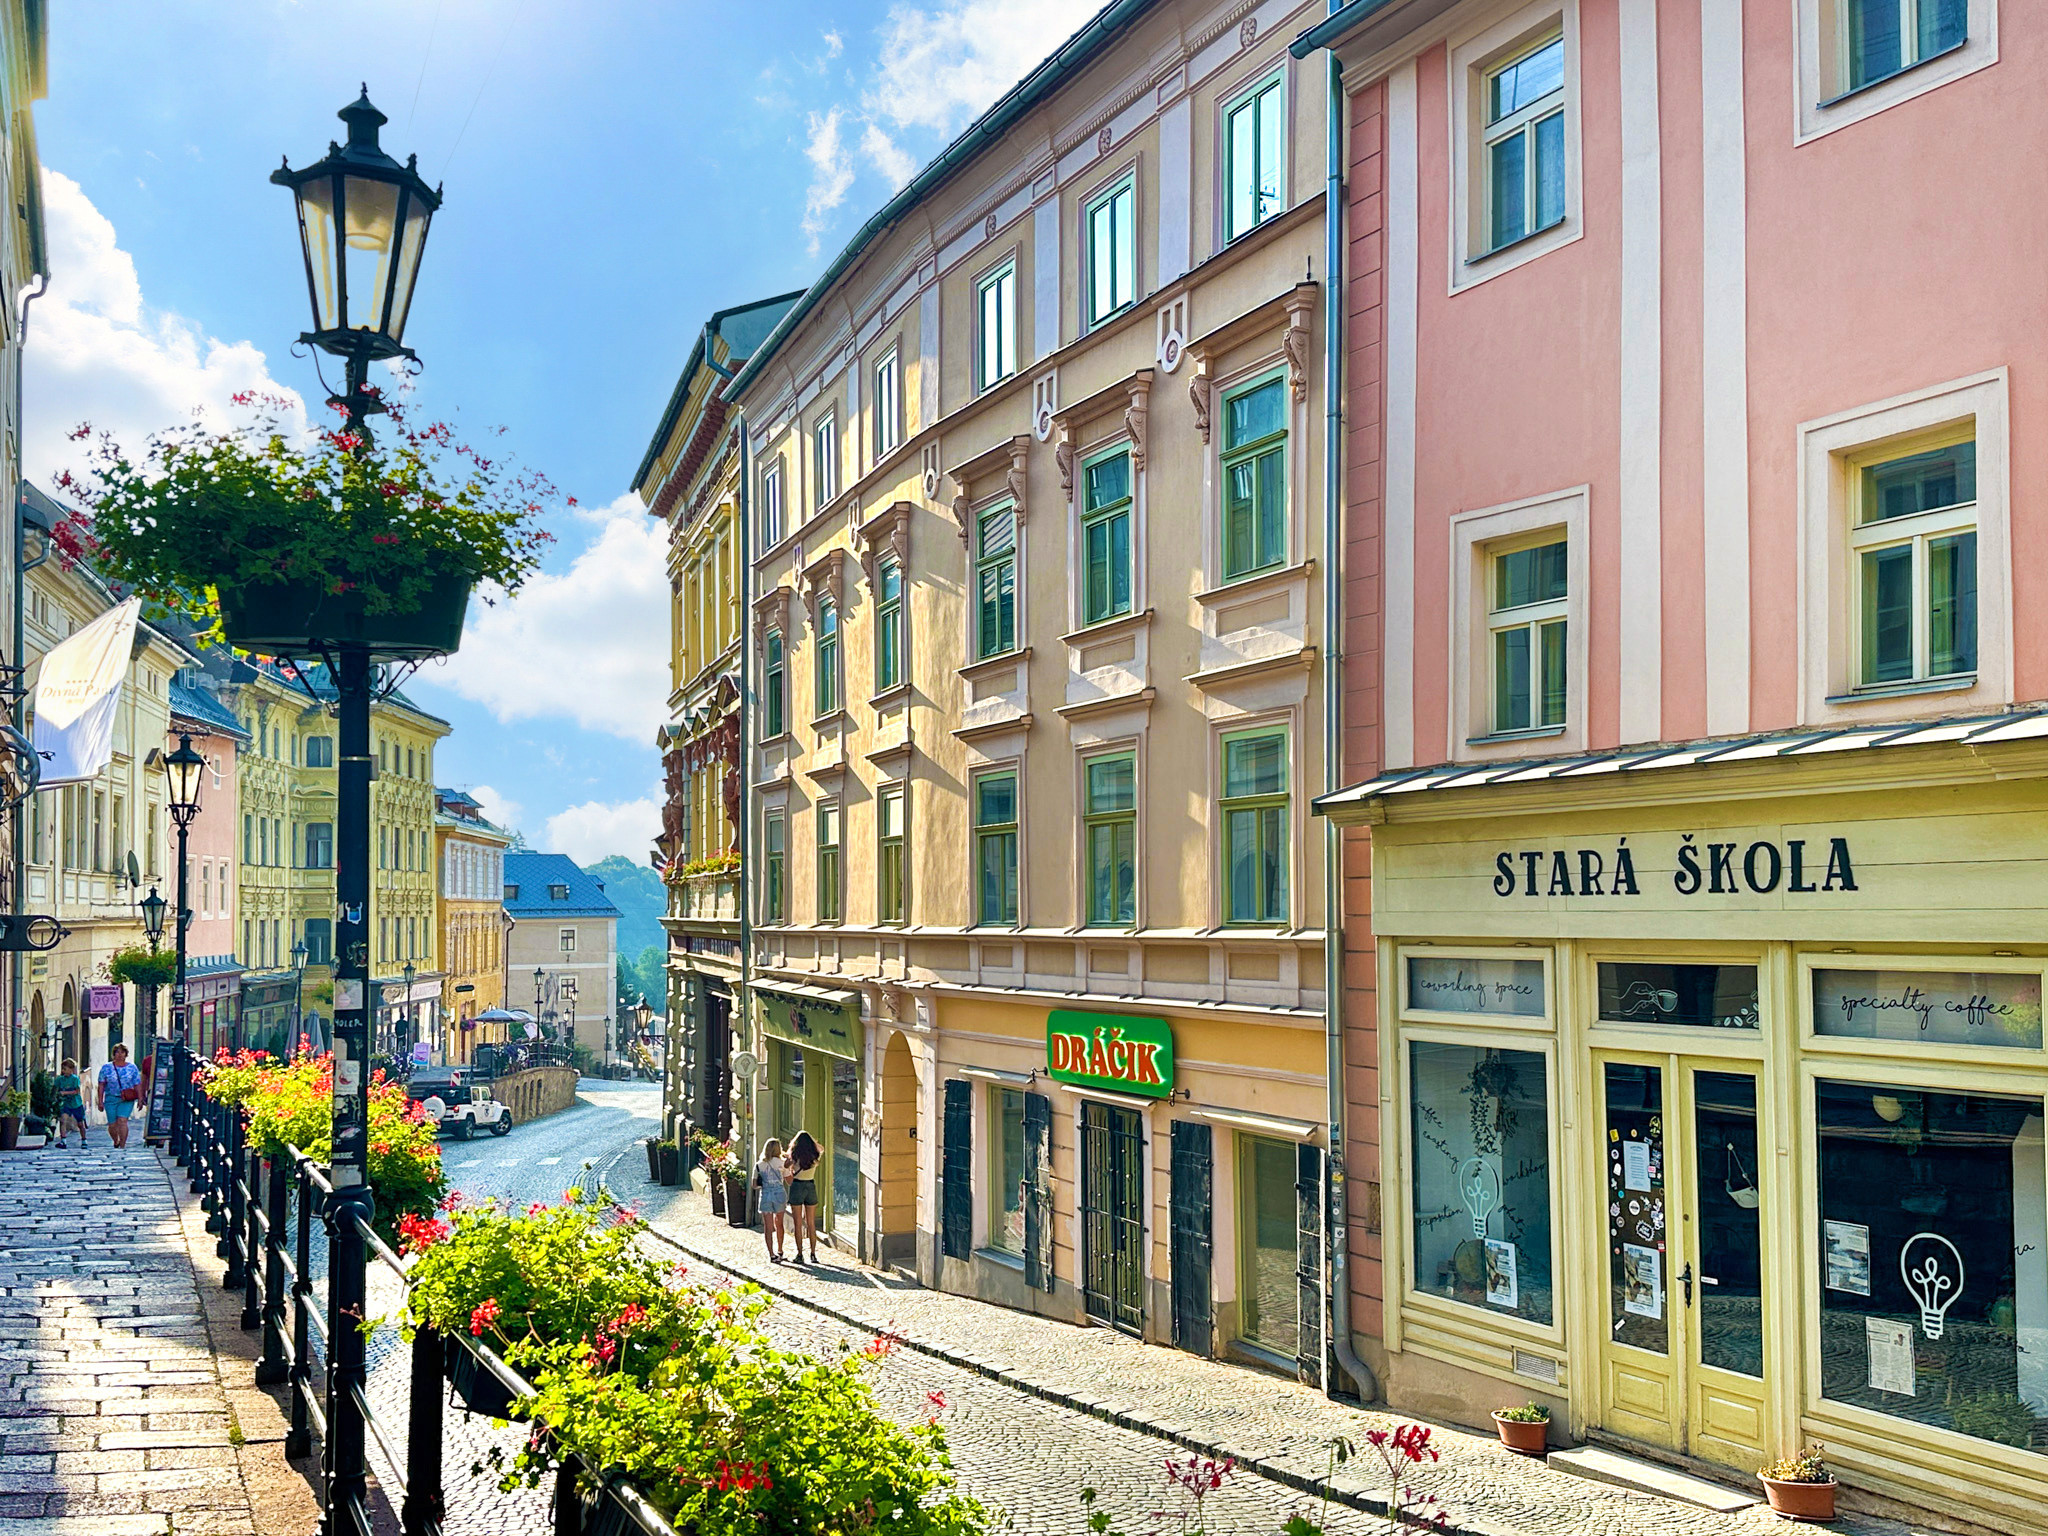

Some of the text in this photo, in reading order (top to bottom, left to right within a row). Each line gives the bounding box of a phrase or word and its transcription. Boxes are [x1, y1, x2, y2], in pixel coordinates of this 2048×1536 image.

[1493, 834, 1859, 897] STARÁ ŠKOLA
[1420, 970, 1533, 1008] coworking space
[1841, 986, 2015, 1031] specialty coffee
[1051, 1026, 1163, 1086] DRÁČIK
[1416, 1100, 1444, 1129] coffee
